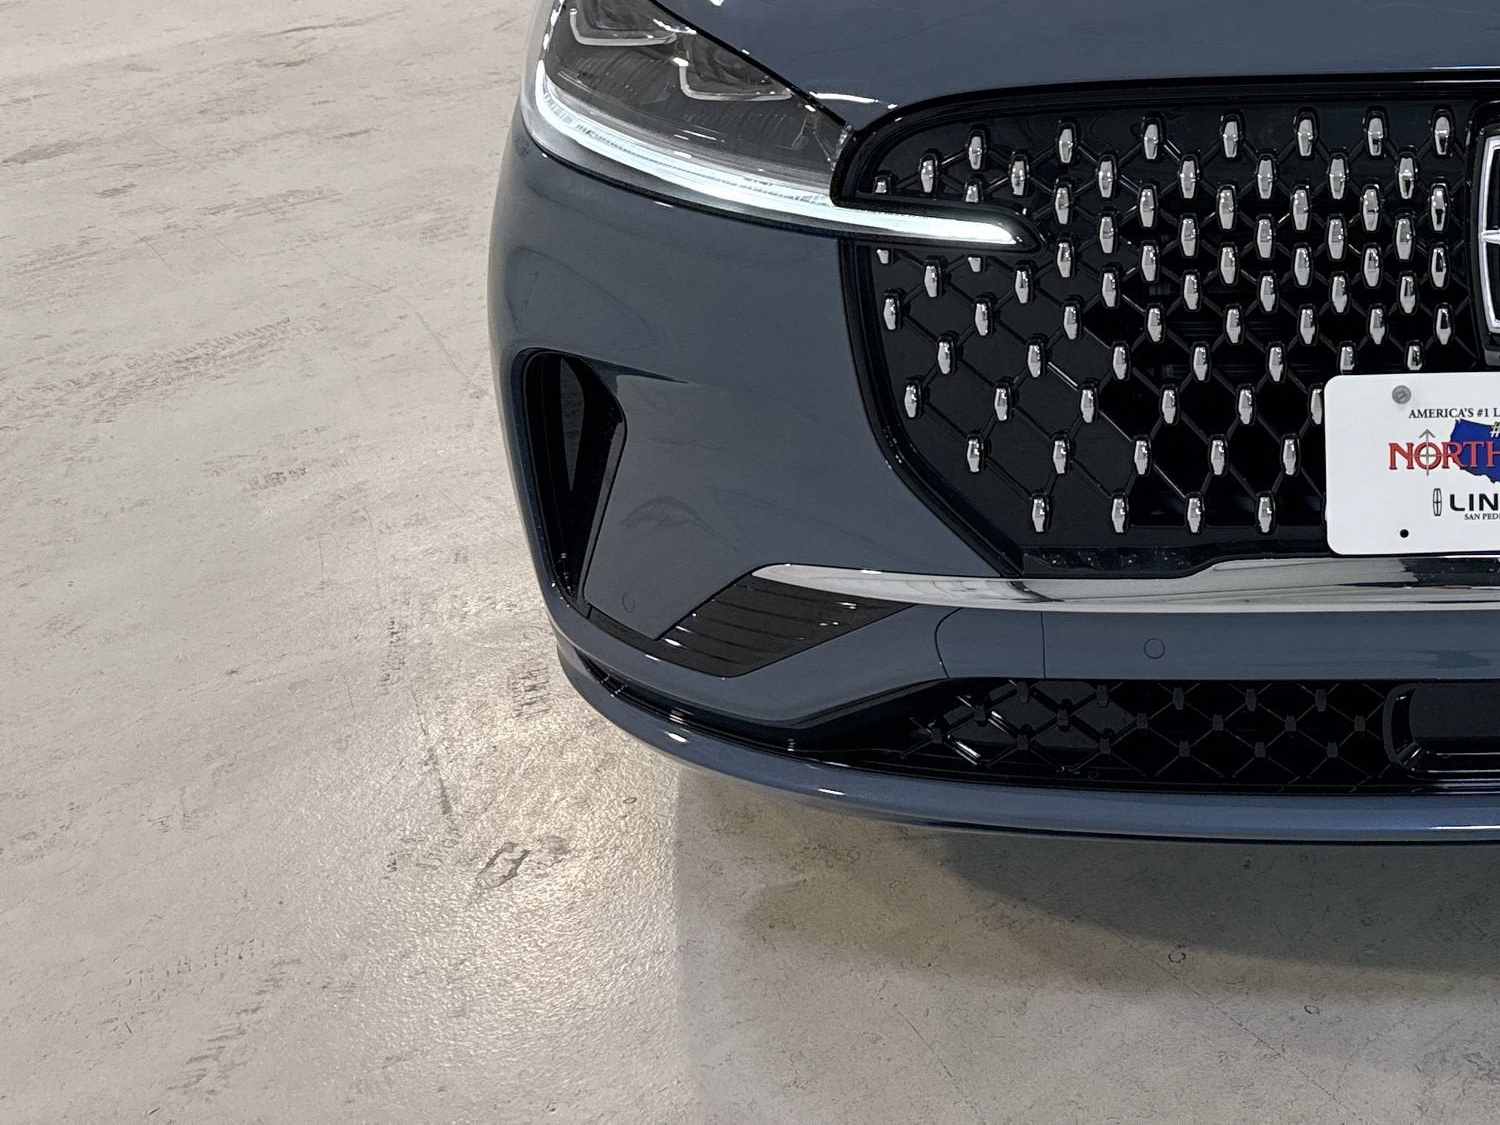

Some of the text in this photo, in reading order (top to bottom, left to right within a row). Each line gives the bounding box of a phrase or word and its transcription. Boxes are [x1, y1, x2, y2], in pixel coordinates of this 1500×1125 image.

[1408, 407, 1474, 419] AMERICA'S
[1476, 407, 1490, 418] #1
[1464, 512, 1482, 521] SAN
